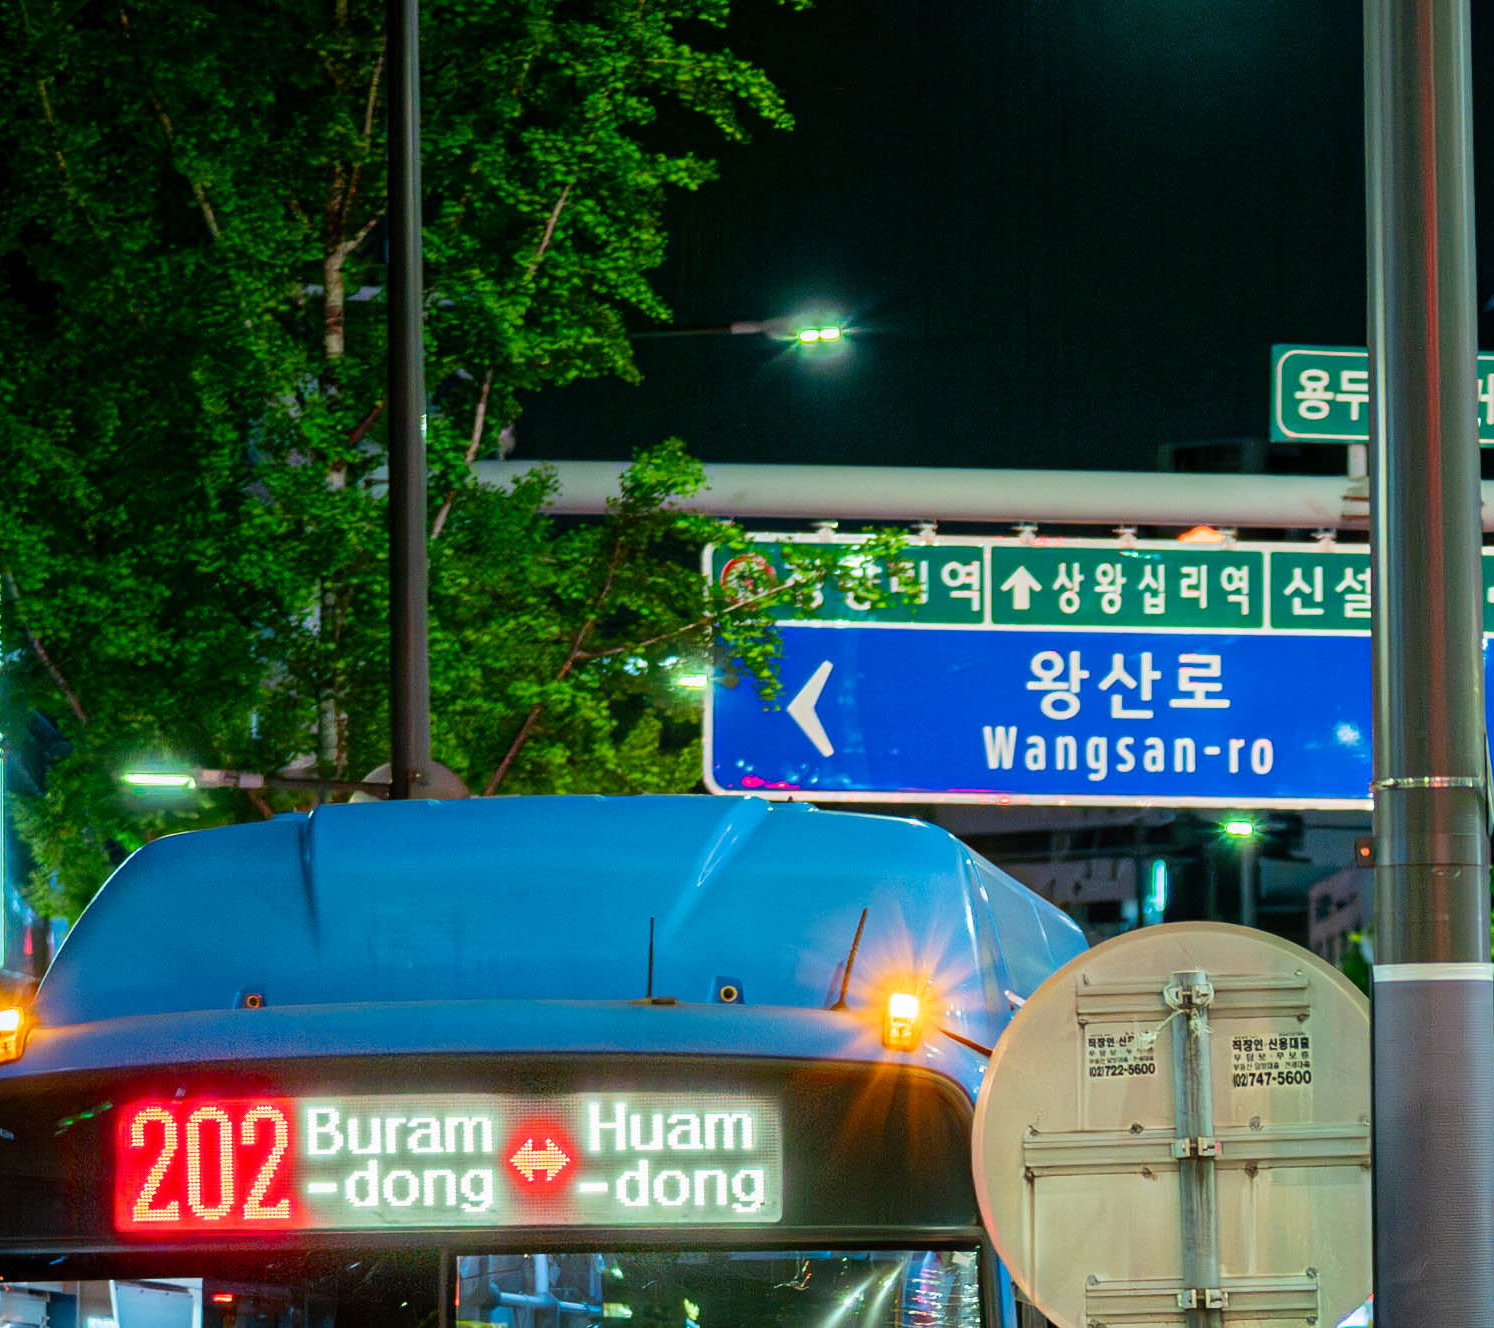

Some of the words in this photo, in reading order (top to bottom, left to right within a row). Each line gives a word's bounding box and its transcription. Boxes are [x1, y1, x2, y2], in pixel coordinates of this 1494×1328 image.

[1052, 562, 1251, 616] 상왕십리역
[1025, 650, 1231, 721] 왕산로
[983, 725, 1274, 781] Wangsan-ro
[1089, 1063, 1156, 1078] (02)722-5600
[1233, 1070, 1312, 1088] (02)747-5600
[307, 1106, 494, 1156] Buram
[589, 1102, 754, 1152] Huam
[130, 1104, 292, 1223] 202
[307, 1159, 494, 1214] -dong
[579, 1159, 766, 1214] -dong
